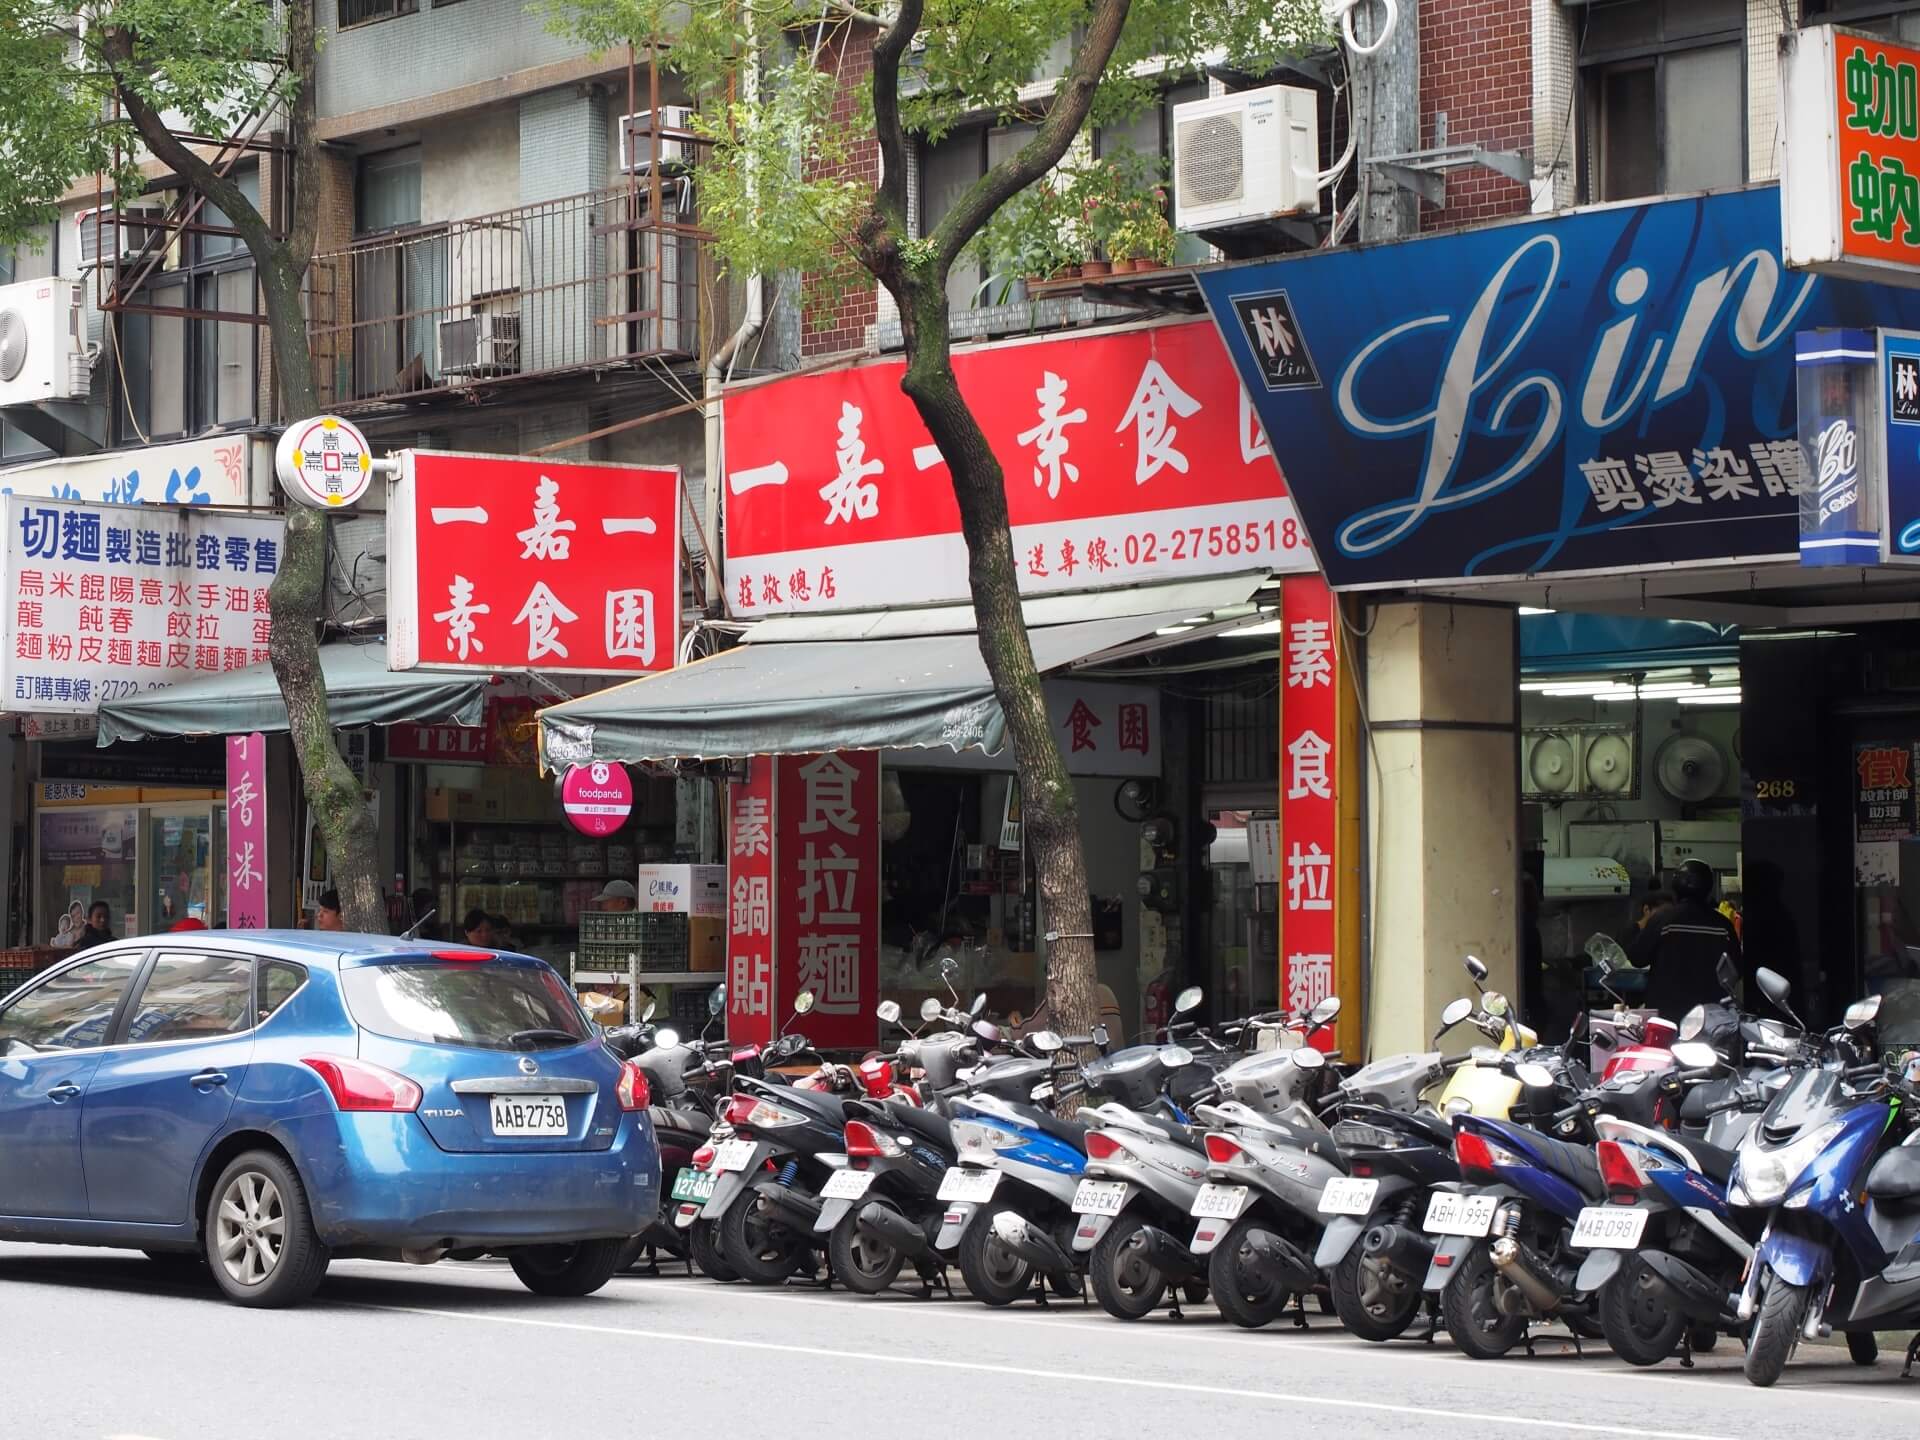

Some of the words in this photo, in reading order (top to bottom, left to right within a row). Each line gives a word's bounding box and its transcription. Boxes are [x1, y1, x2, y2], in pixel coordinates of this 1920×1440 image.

[1250, 306, 1296, 359] 林
[1267, 356, 1307, 379] Lin
[1895, 362, 1918, 401] 林
[1338, 234, 1816, 552] Lin
[1895, 400, 1919, 416] Lin
[430, 474, 657, 561] 一嘉一
[738, 566, 837, 611] 莊敬總店
[432, 574, 656, 667] 素食園
[578, 787, 623, 801] foodpanda
[1756, 780, 1795, 799] 268
[1868, 805, 1901, 818] 助理
[1287, 619, 1332, 1027] 素食拉麵
[732, 796, 769, 1016] 素鍋貼
[797, 752, 861, 1016] 食拉麵
[424, 1109, 465, 1118] TIIDA
